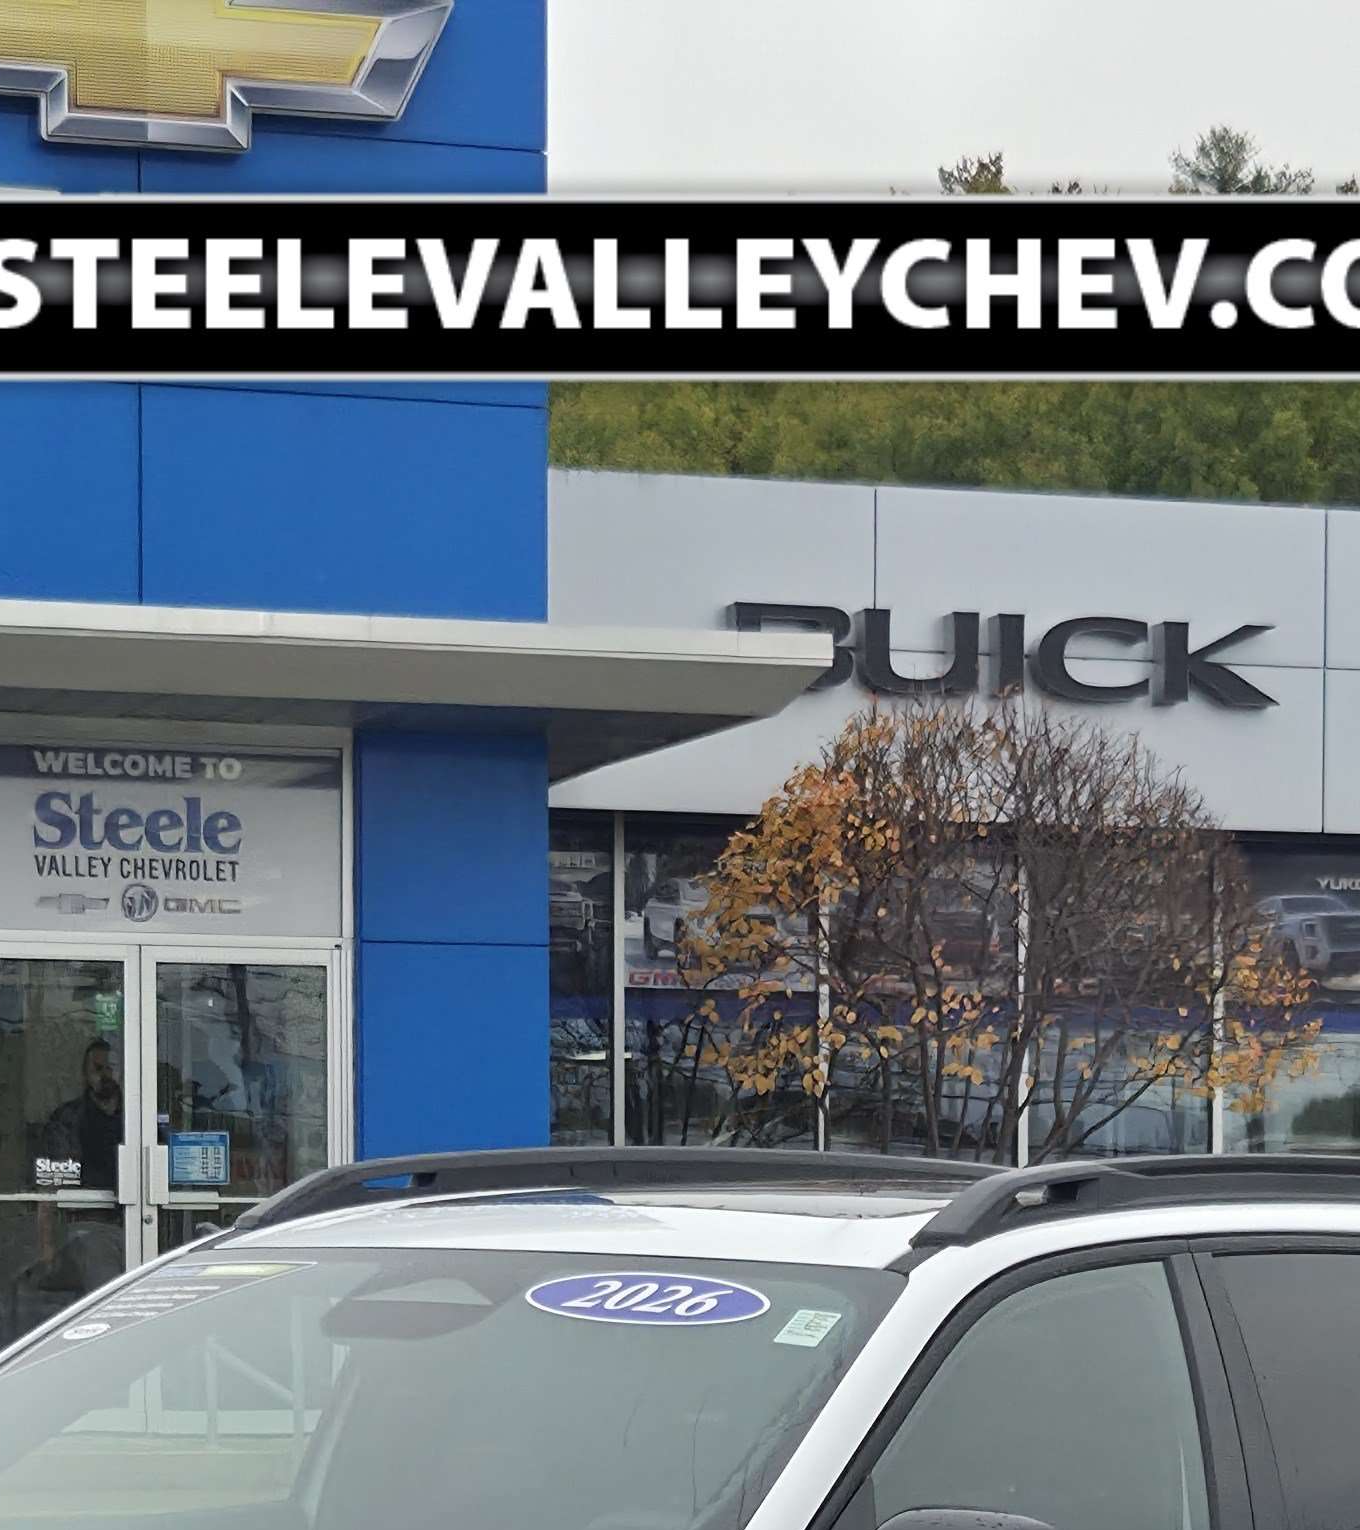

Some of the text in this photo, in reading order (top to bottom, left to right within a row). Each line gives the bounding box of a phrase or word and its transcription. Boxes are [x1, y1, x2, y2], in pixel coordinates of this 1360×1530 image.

[34, 751, 243, 780] WELCOME TO
[33, 791, 242, 855] Steele
[34, 855, 239, 882] VALLEY CHEVROLET
[628, 969, 681, 987] GM
[562, 1280, 734, 1316] 2026
